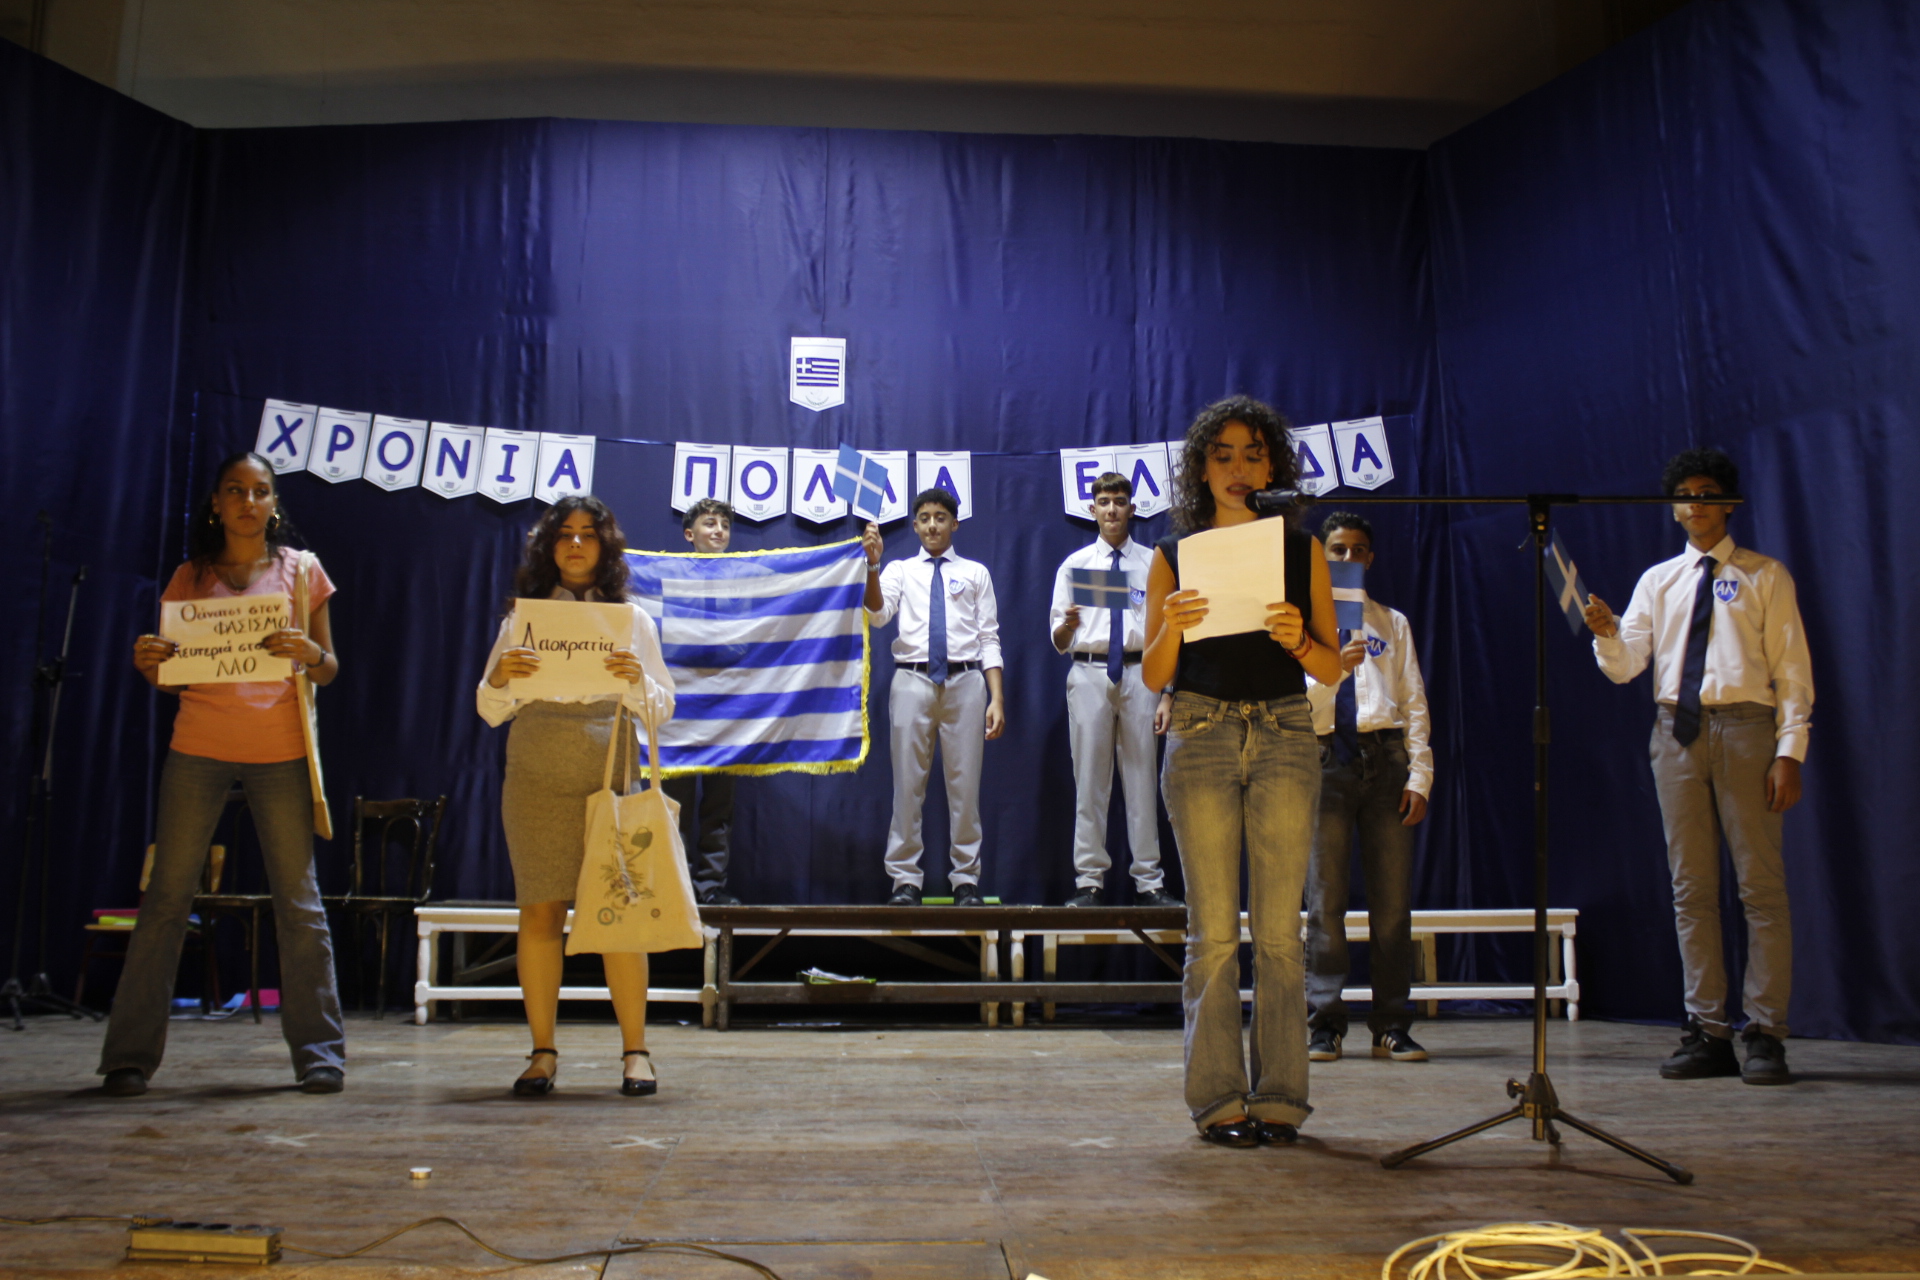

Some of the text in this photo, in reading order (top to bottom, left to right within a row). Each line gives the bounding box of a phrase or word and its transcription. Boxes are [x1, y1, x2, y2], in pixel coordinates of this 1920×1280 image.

[266, 414, 582, 490] ΧΡΟΝΙΑ
[1076, 432, 1383, 499] ΕΛΔΑ
[521, 622, 615, 661] Λαοκρατία
